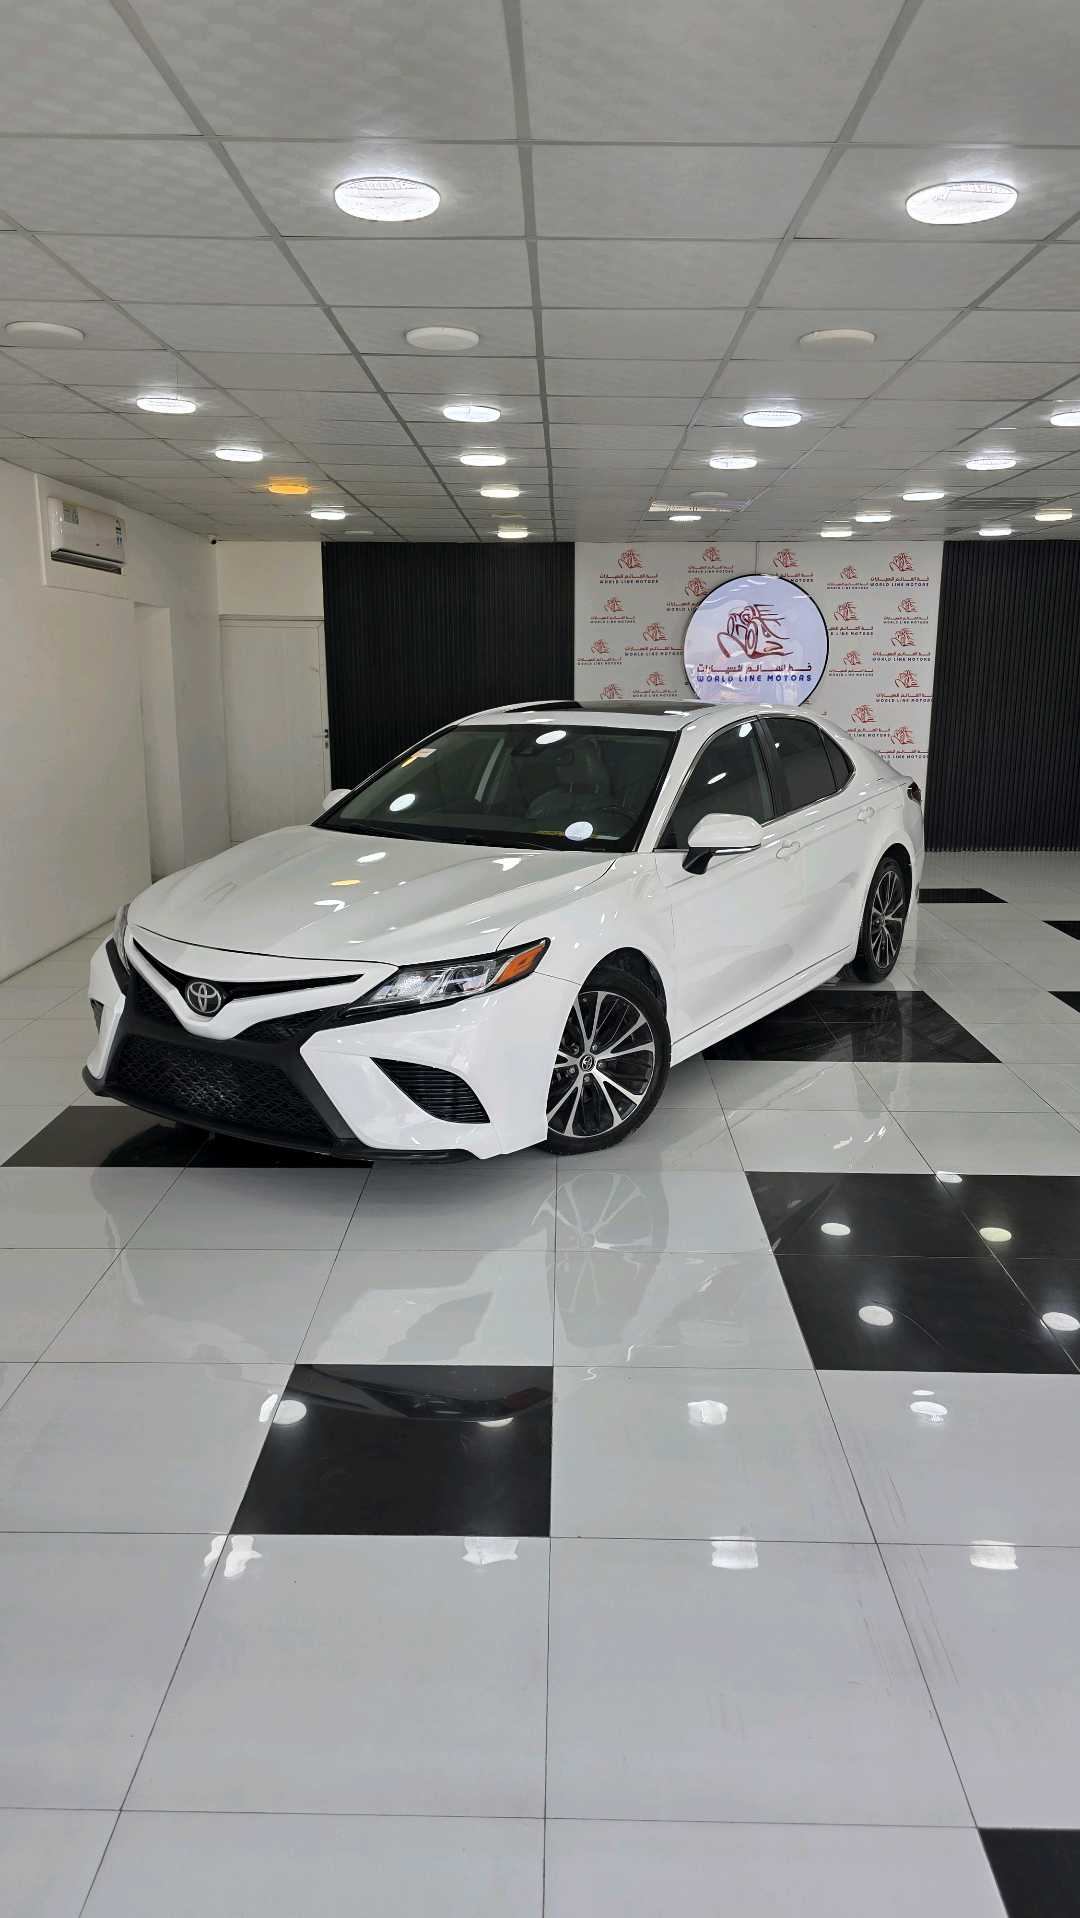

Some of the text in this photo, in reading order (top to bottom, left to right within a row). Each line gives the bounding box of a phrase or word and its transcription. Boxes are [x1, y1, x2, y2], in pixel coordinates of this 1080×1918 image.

[788, 662, 813, 672] خط
[696, 674, 734, 683] WORLD
[739, 674, 762, 683] LINE
[767, 674, 813, 682] MOTORS
